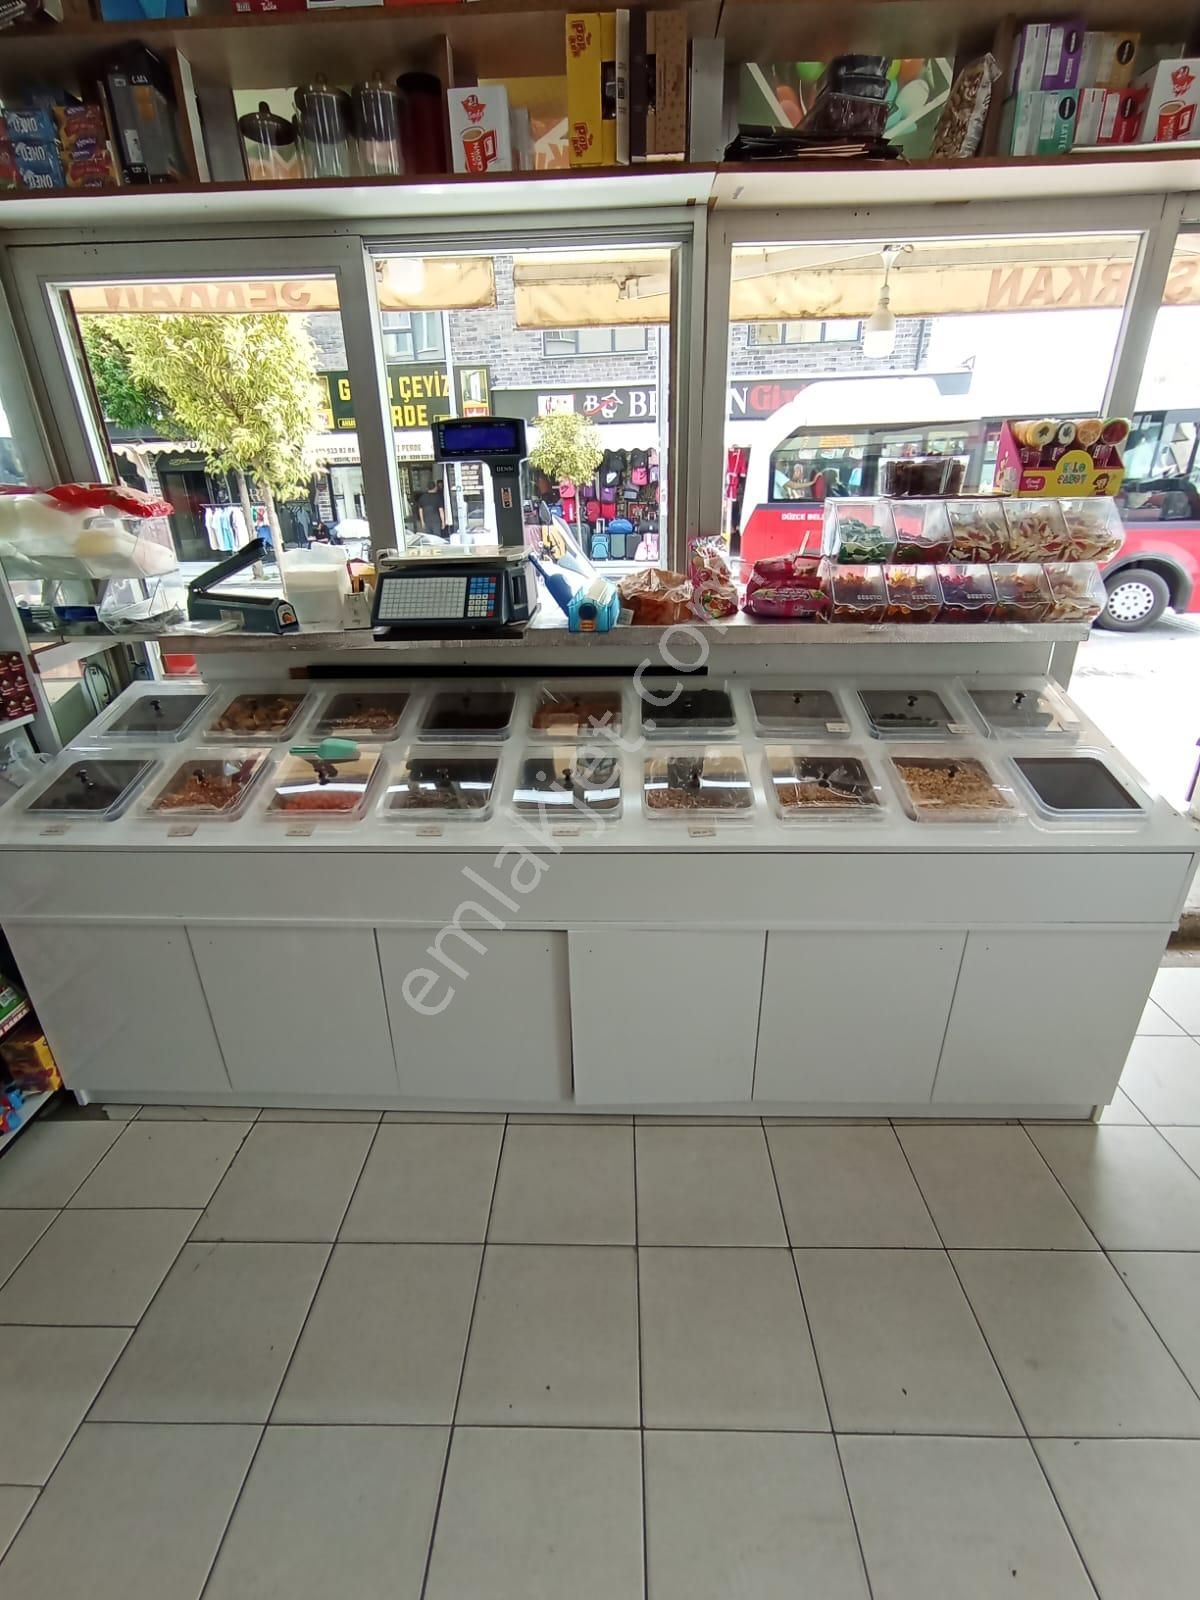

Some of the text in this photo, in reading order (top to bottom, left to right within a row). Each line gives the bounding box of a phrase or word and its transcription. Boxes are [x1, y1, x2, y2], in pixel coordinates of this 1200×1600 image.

[400, 370, 449, 403] ÇEYİZ
[392, 405, 428, 427] RDE
[781, 511, 806, 521] DÜZCE
